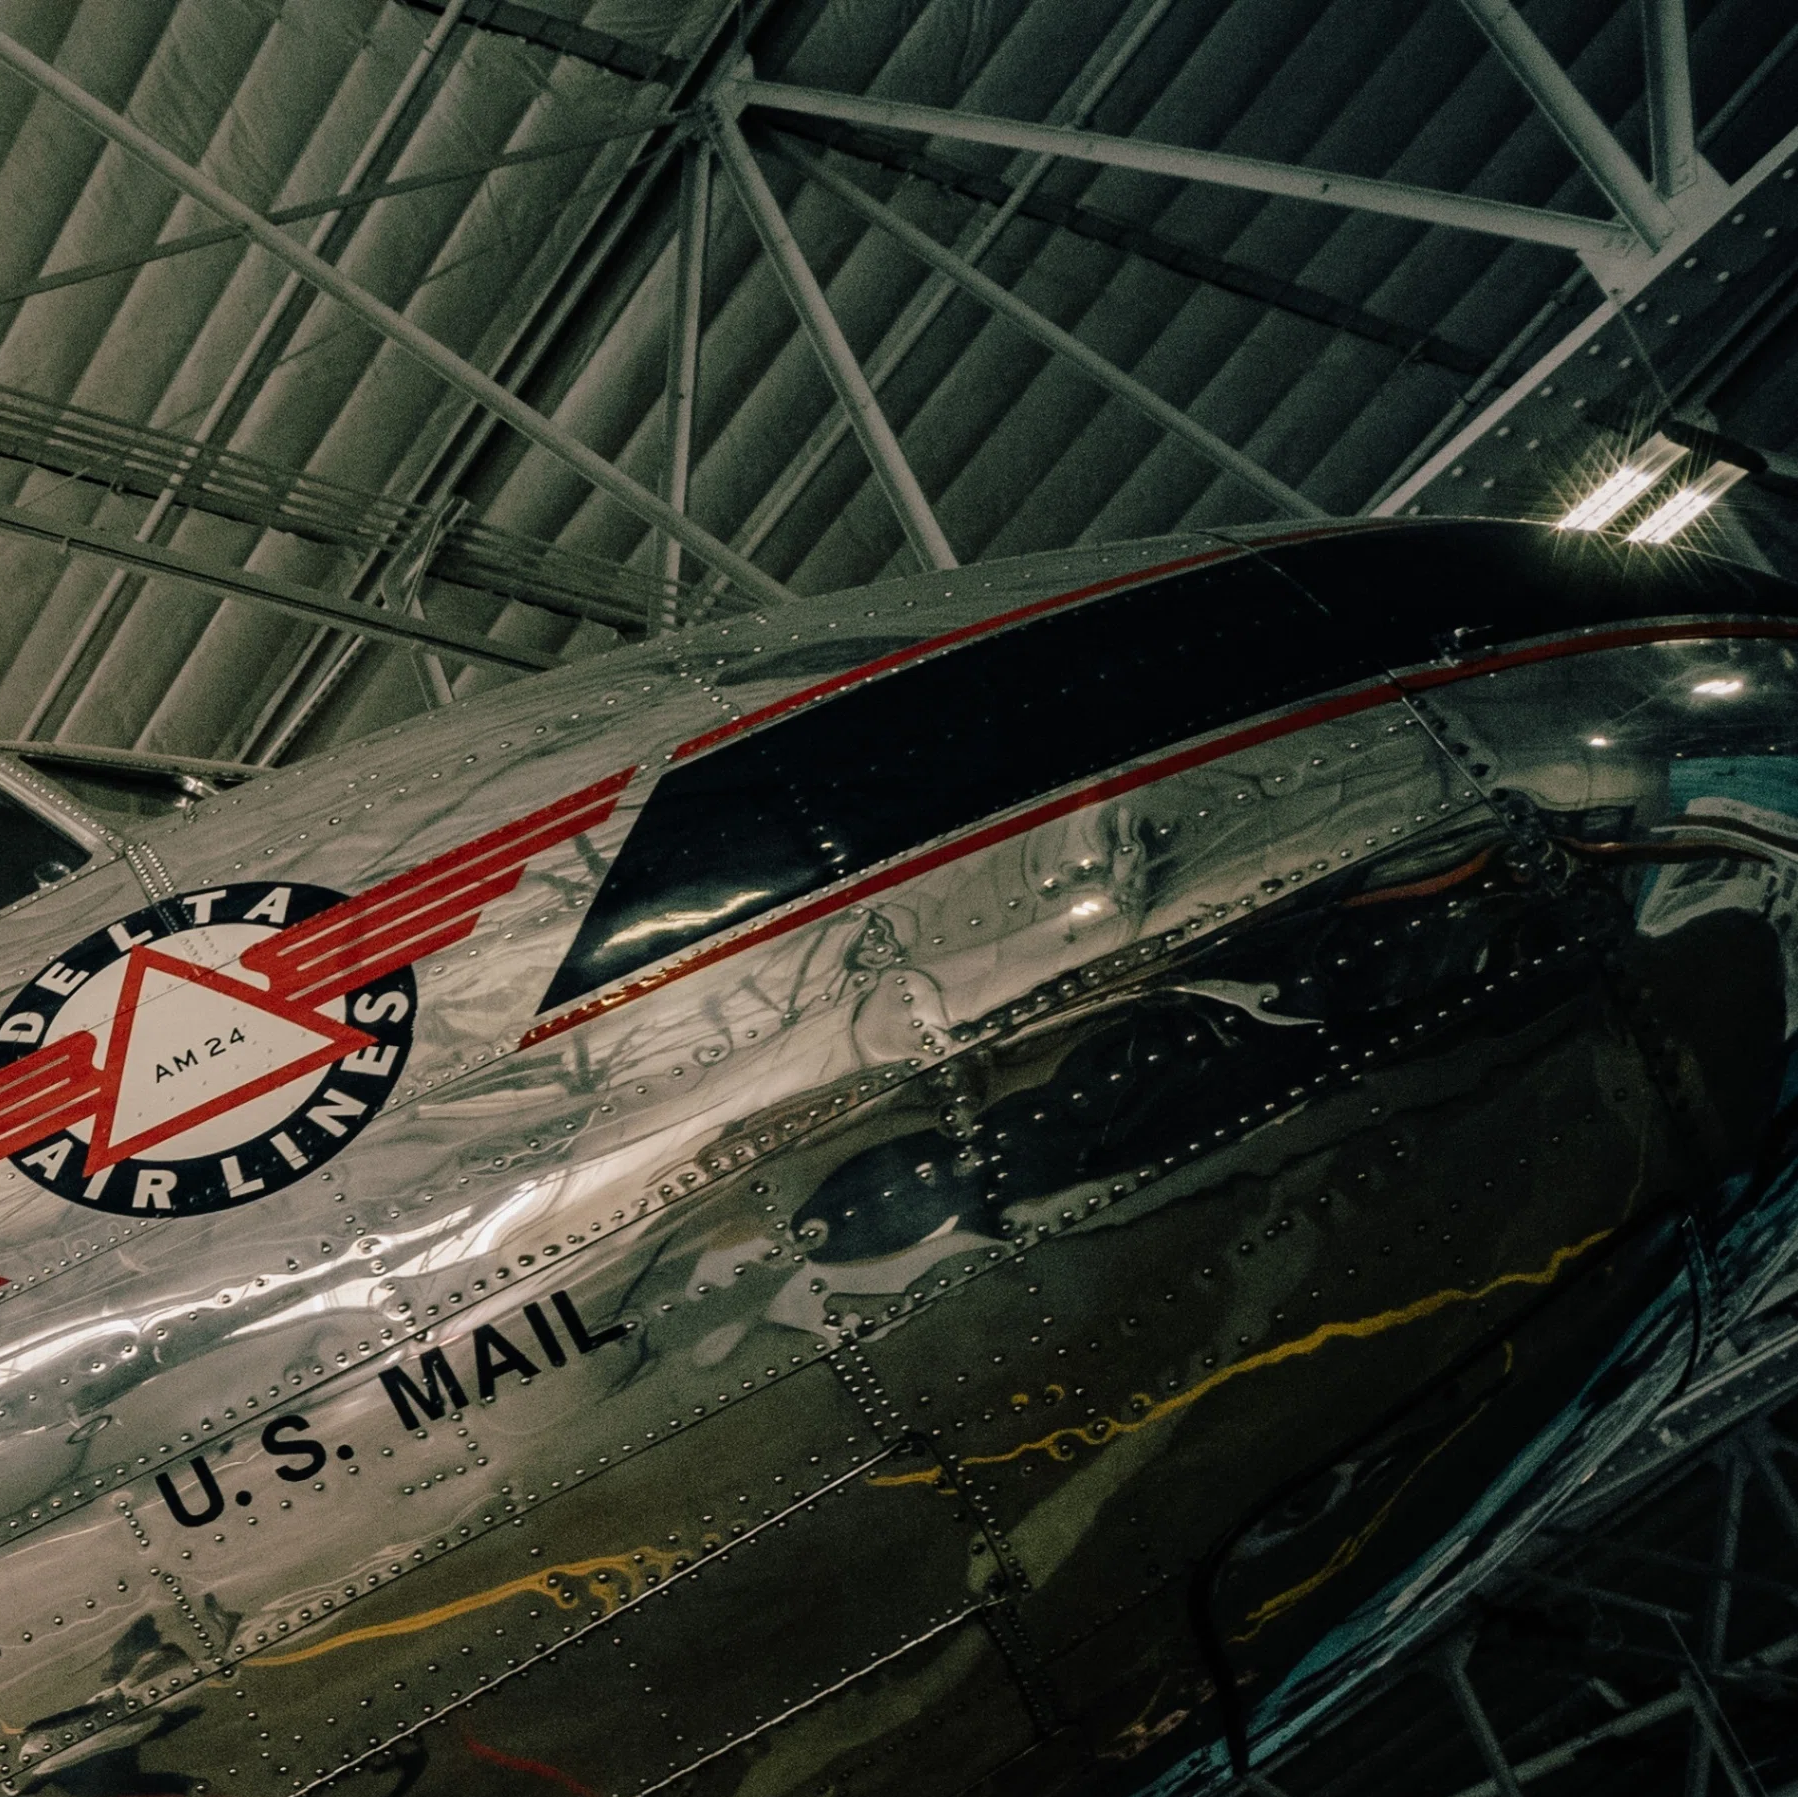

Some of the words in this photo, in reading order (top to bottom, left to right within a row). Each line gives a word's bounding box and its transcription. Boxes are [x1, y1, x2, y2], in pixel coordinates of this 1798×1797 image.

[21, 991, 411, 1210] AIRLINES
[154, 1048, 198, 1084] AM
[205, 1026, 247, 1057] 24
[155, 1455, 253, 1529] U.
[261, 1414, 355, 1483] S.
[378, 1289, 629, 1432] MAIL
